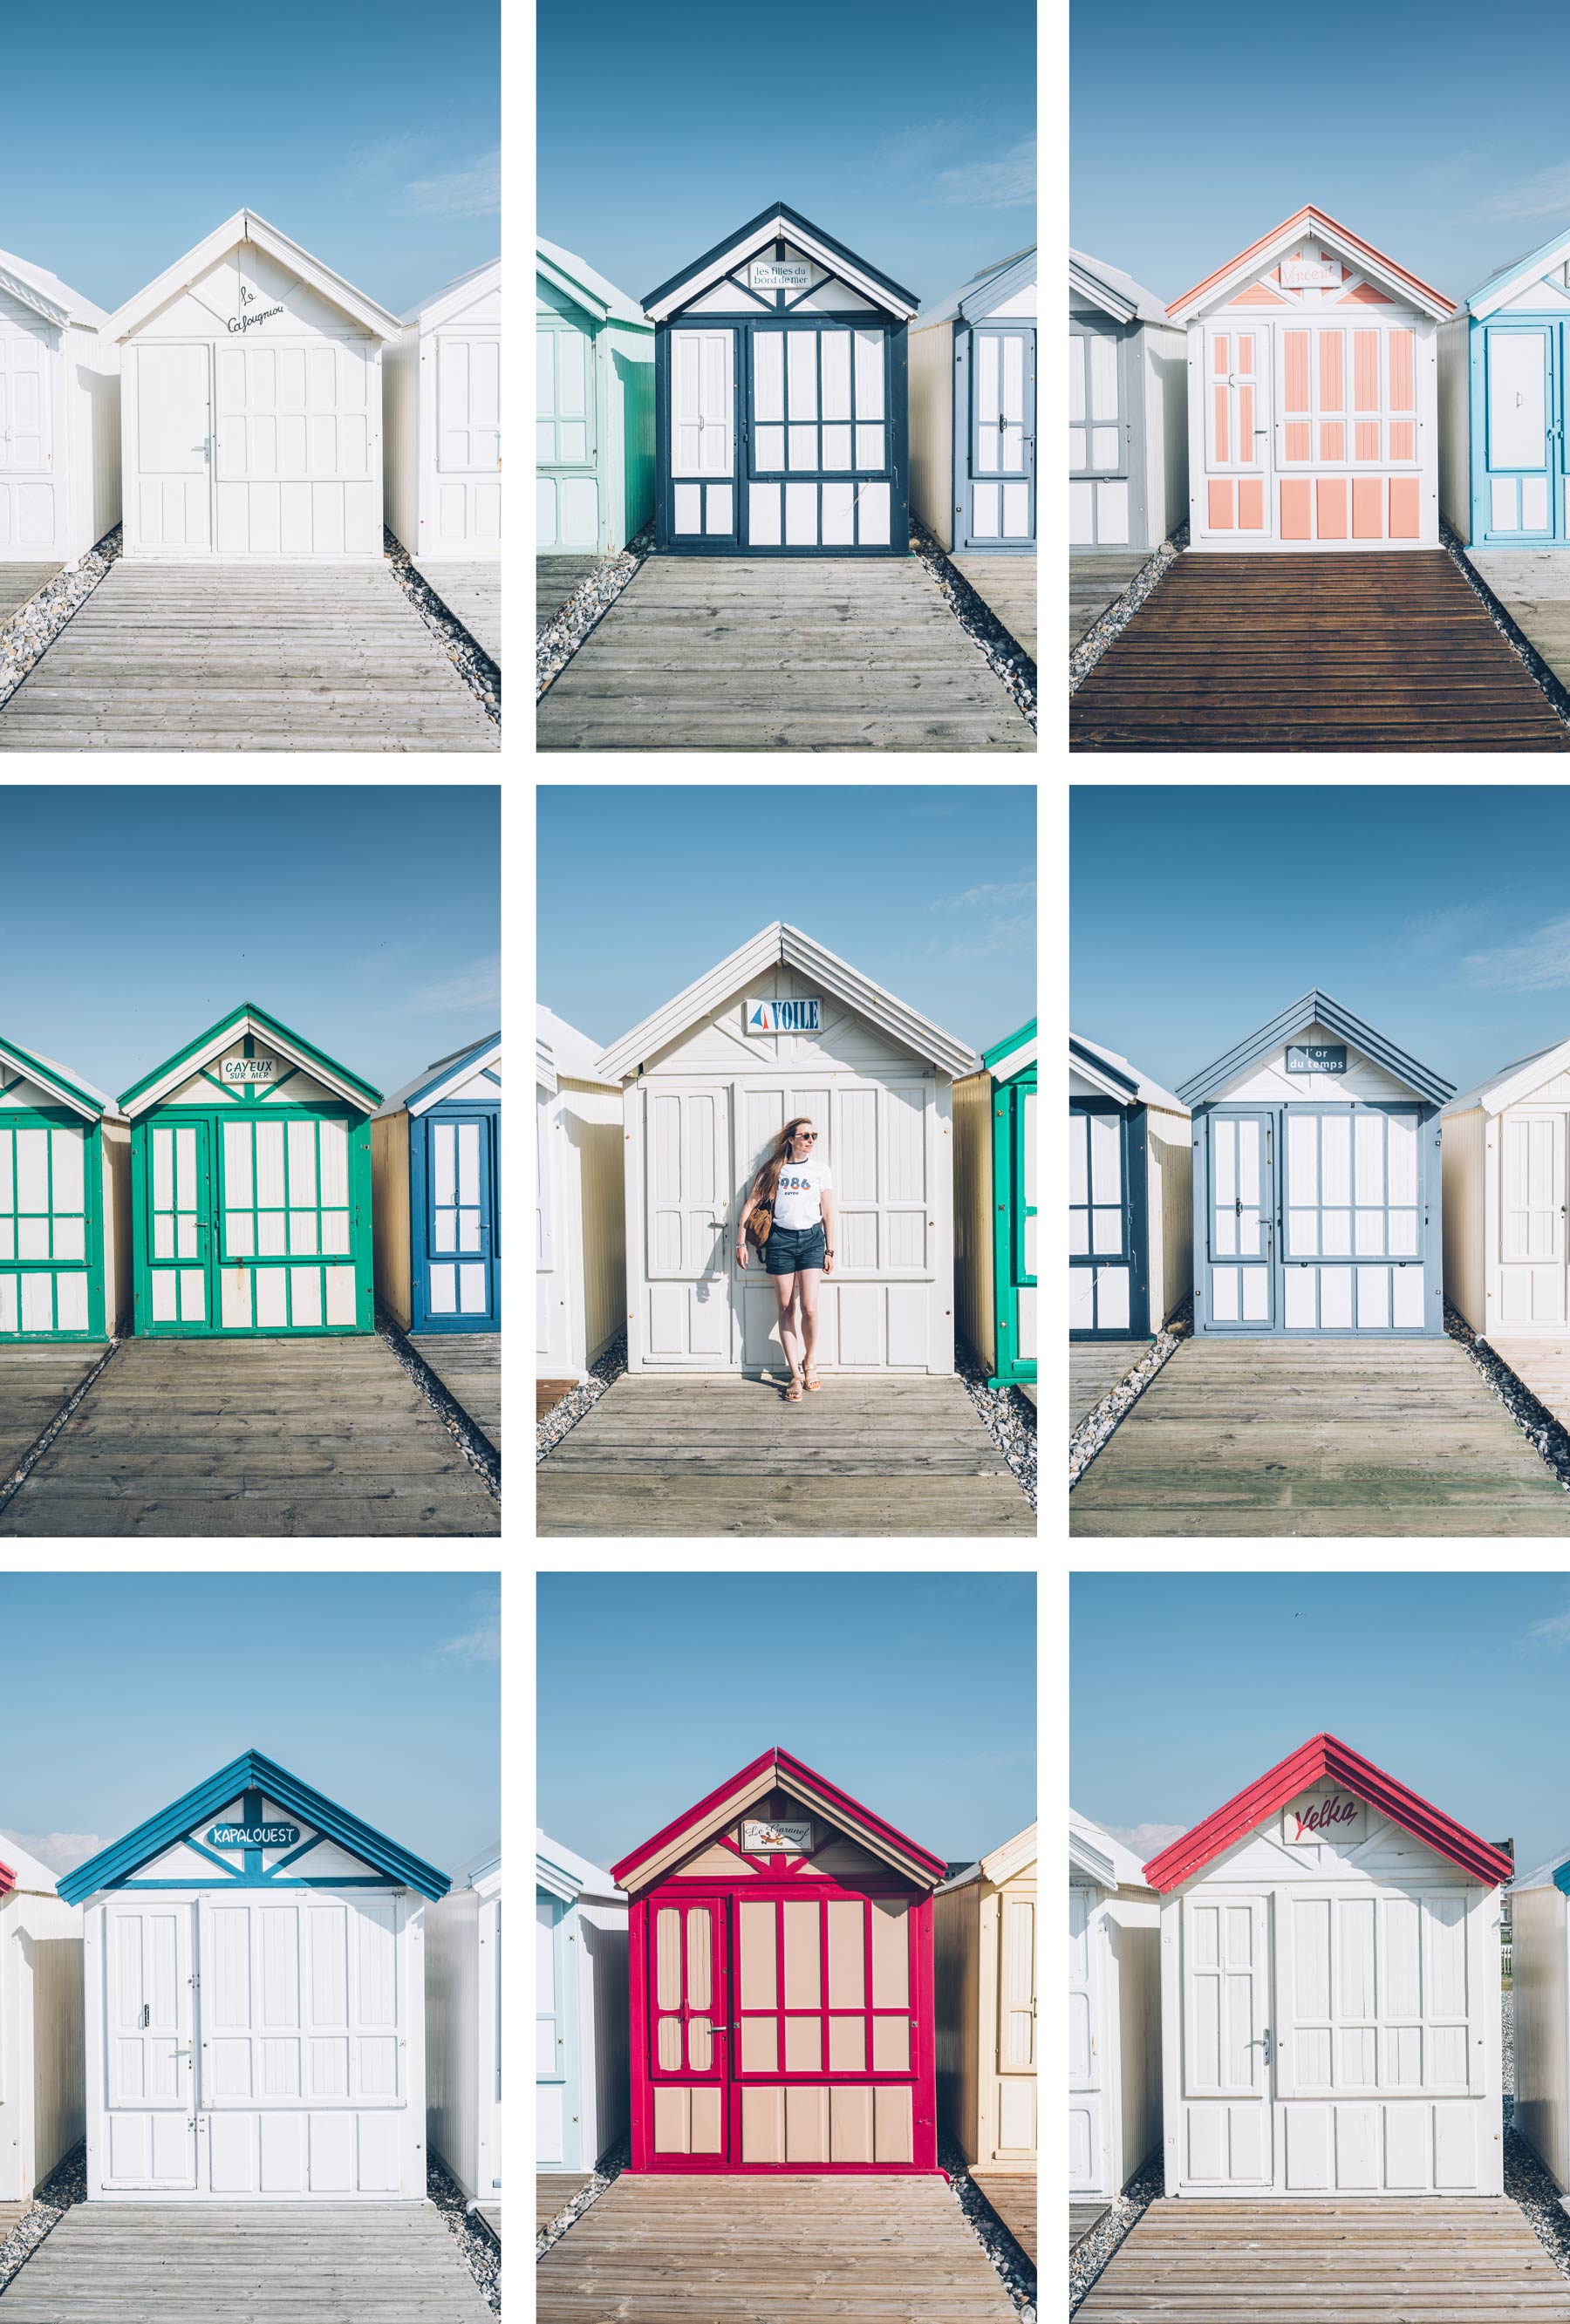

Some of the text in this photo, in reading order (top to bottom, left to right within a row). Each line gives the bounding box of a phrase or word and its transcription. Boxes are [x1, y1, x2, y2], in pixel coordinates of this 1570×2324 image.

[1282, 264, 1334, 283] Vincent
[241, 286, 256, 306] Le
[771, 1000, 818, 1030] VOILE
[225, 1060, 272, 1073] CAYEUX
[1290, 1059, 1343, 1071] du temps
[777, 1177, 811, 1190] 986
[1295, 1796, 1358, 1841] Yelka
[214, 1828, 295, 1843] KAPALOUEST
[745, 1825, 763, 1837] Le
